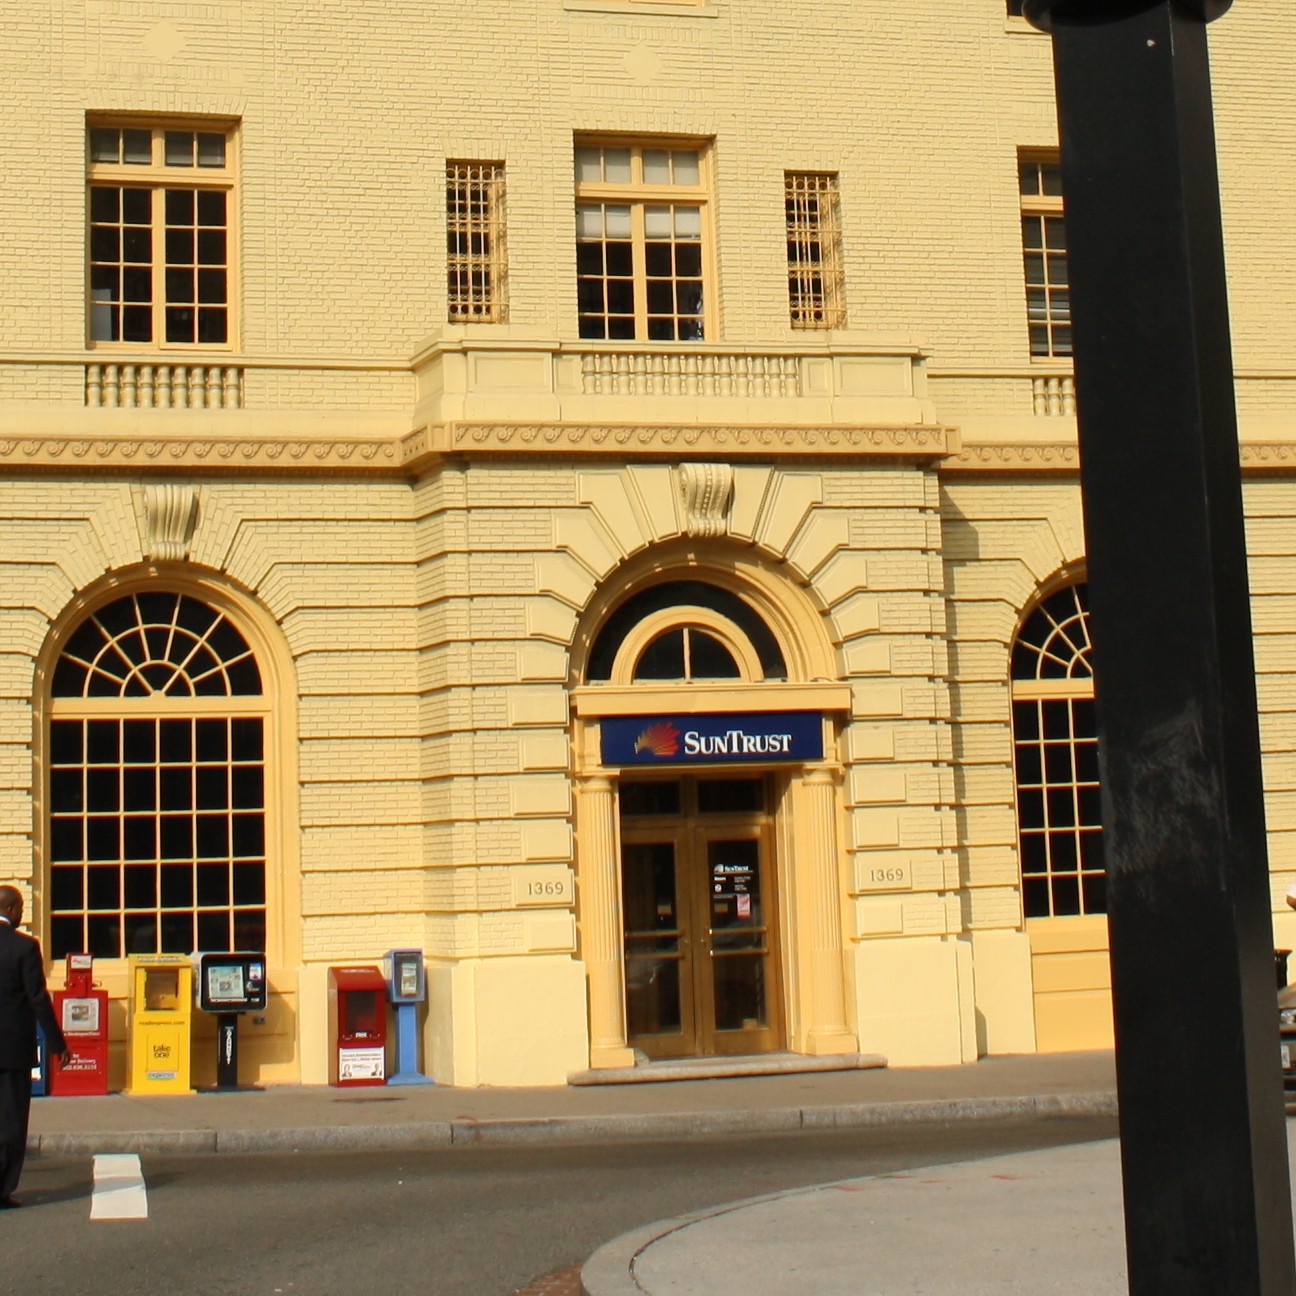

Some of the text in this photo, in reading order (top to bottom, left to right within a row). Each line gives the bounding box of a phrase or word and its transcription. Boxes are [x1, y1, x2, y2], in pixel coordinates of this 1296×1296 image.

[684, 730, 792, 754] SUNTRUST
[869, 869, 904, 882] 1369
[527, 882, 564, 895] 1369
[153, 1044, 171, 1052] take
